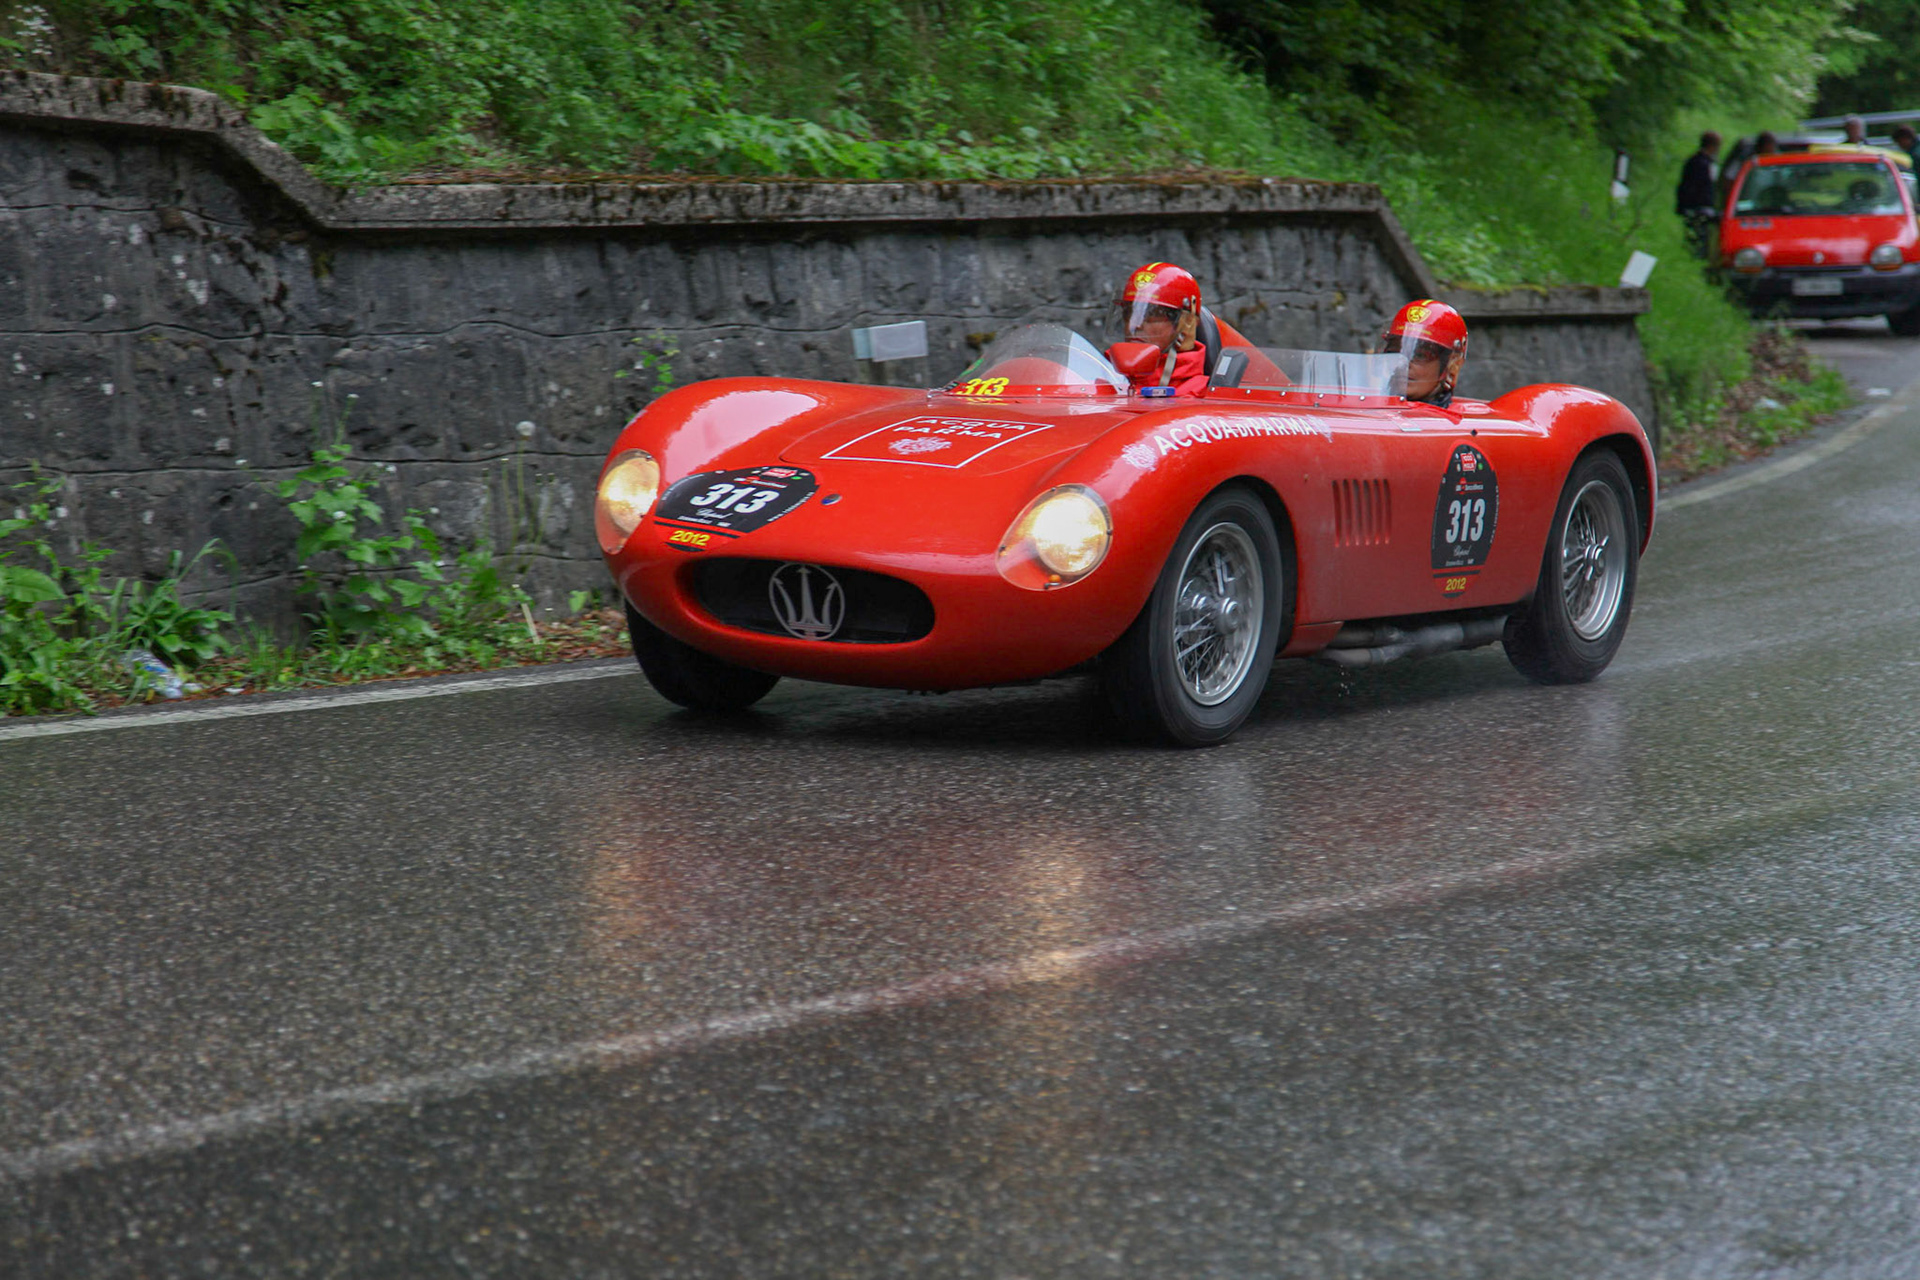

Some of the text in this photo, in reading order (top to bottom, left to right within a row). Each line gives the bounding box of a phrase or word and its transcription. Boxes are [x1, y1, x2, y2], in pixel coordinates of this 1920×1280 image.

[957, 377, 1010, 396] 313
[893, 426, 1002, 438] PARMA
[916, 419, 1025, 430] ACQUA
[1153, 418, 1238, 456] ACQUA
[1246, 417, 1318, 436] PARMA
[690, 483, 780, 514] 313
[1446, 498, 1486, 543] 313
[670, 530, 711, 546] 2012
[1445, 577, 1467, 591] 2012
